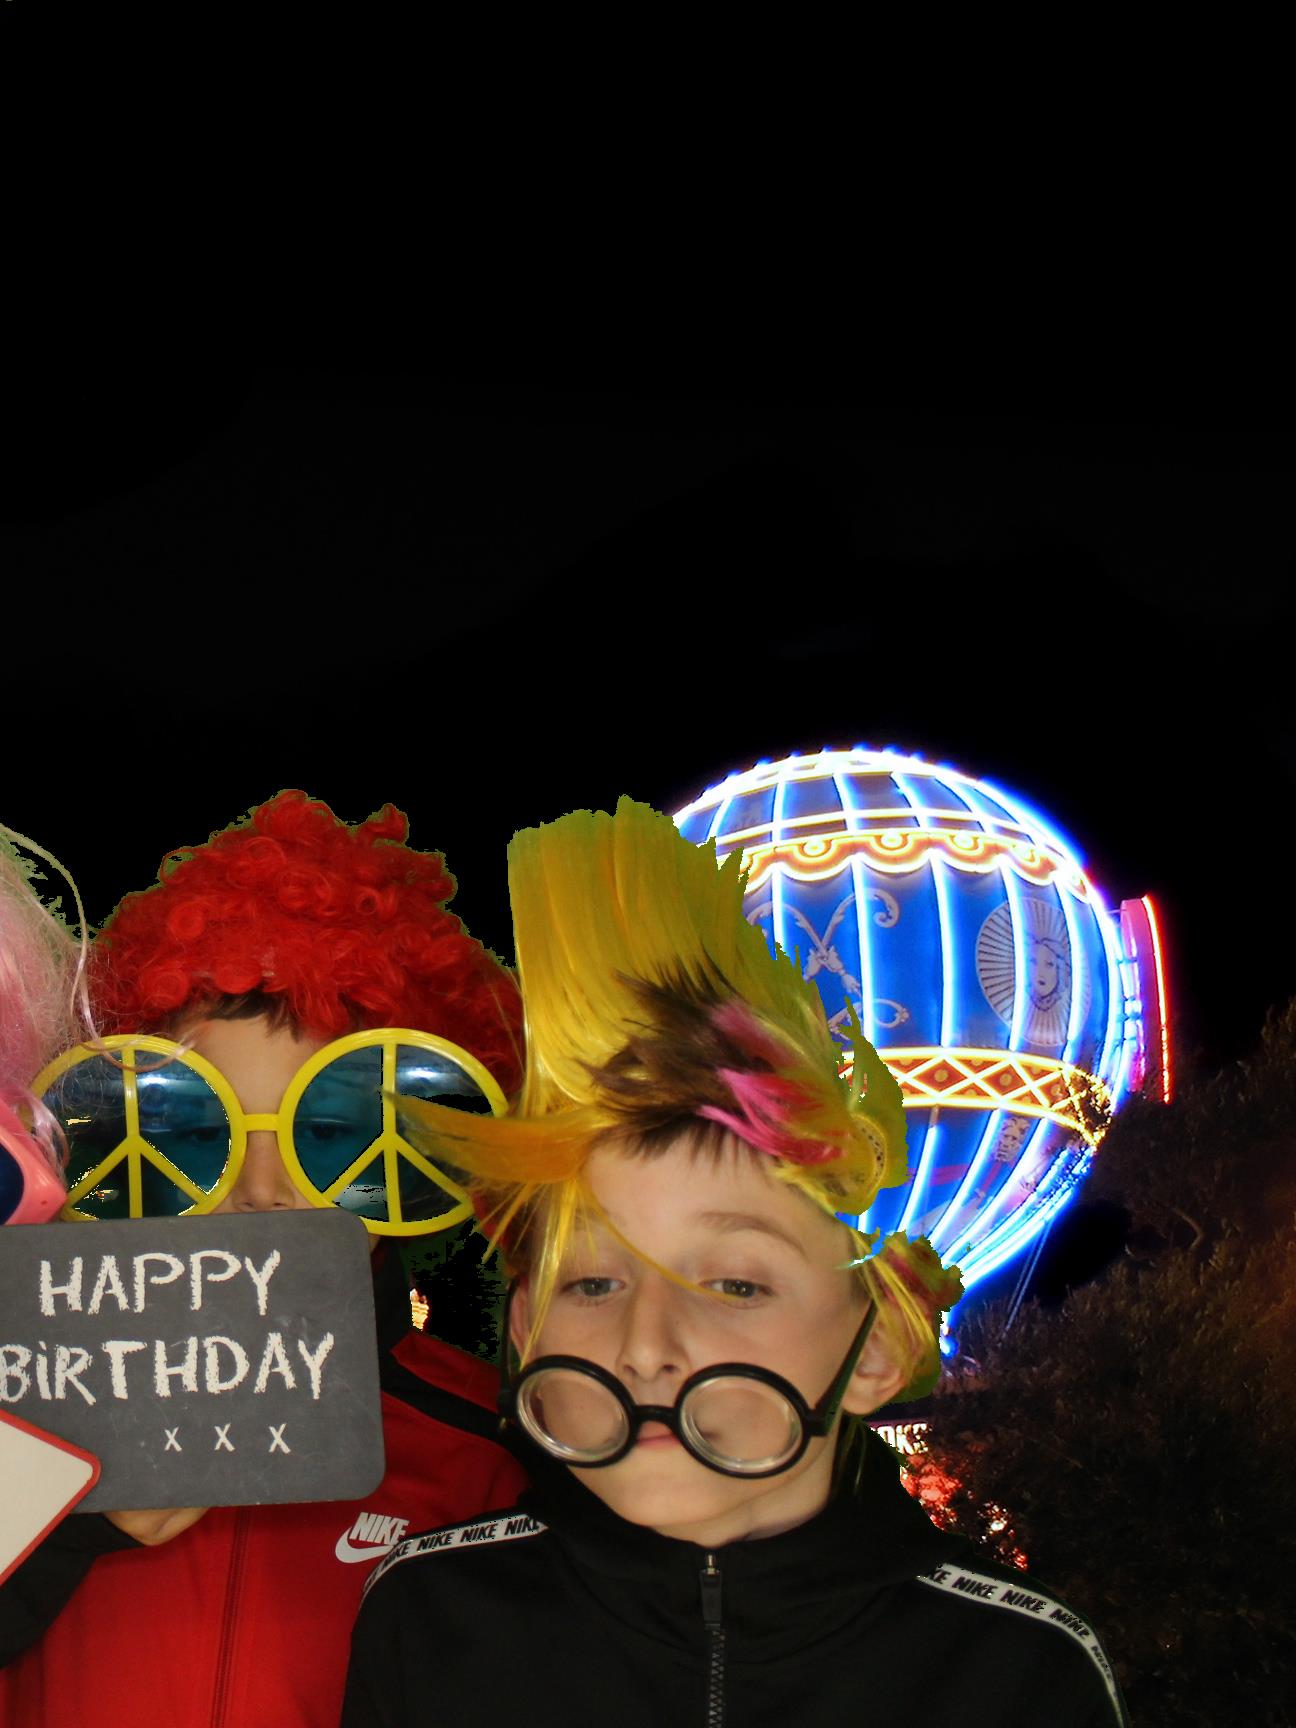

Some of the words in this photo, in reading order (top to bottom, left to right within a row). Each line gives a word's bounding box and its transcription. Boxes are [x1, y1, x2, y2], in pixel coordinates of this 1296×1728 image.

[39, 1249, 281, 1316] HAPPY
[870, 1423, 929, 1455] OKE
[349, 1511, 410, 1546] NIKE
[416, 1531, 455, 1552] NIKE
[460, 1523, 499, 1543] NIKE
[951, 1575, 999, 1600] NIKE
[1000, 1589, 1047, 1614] NIKE
